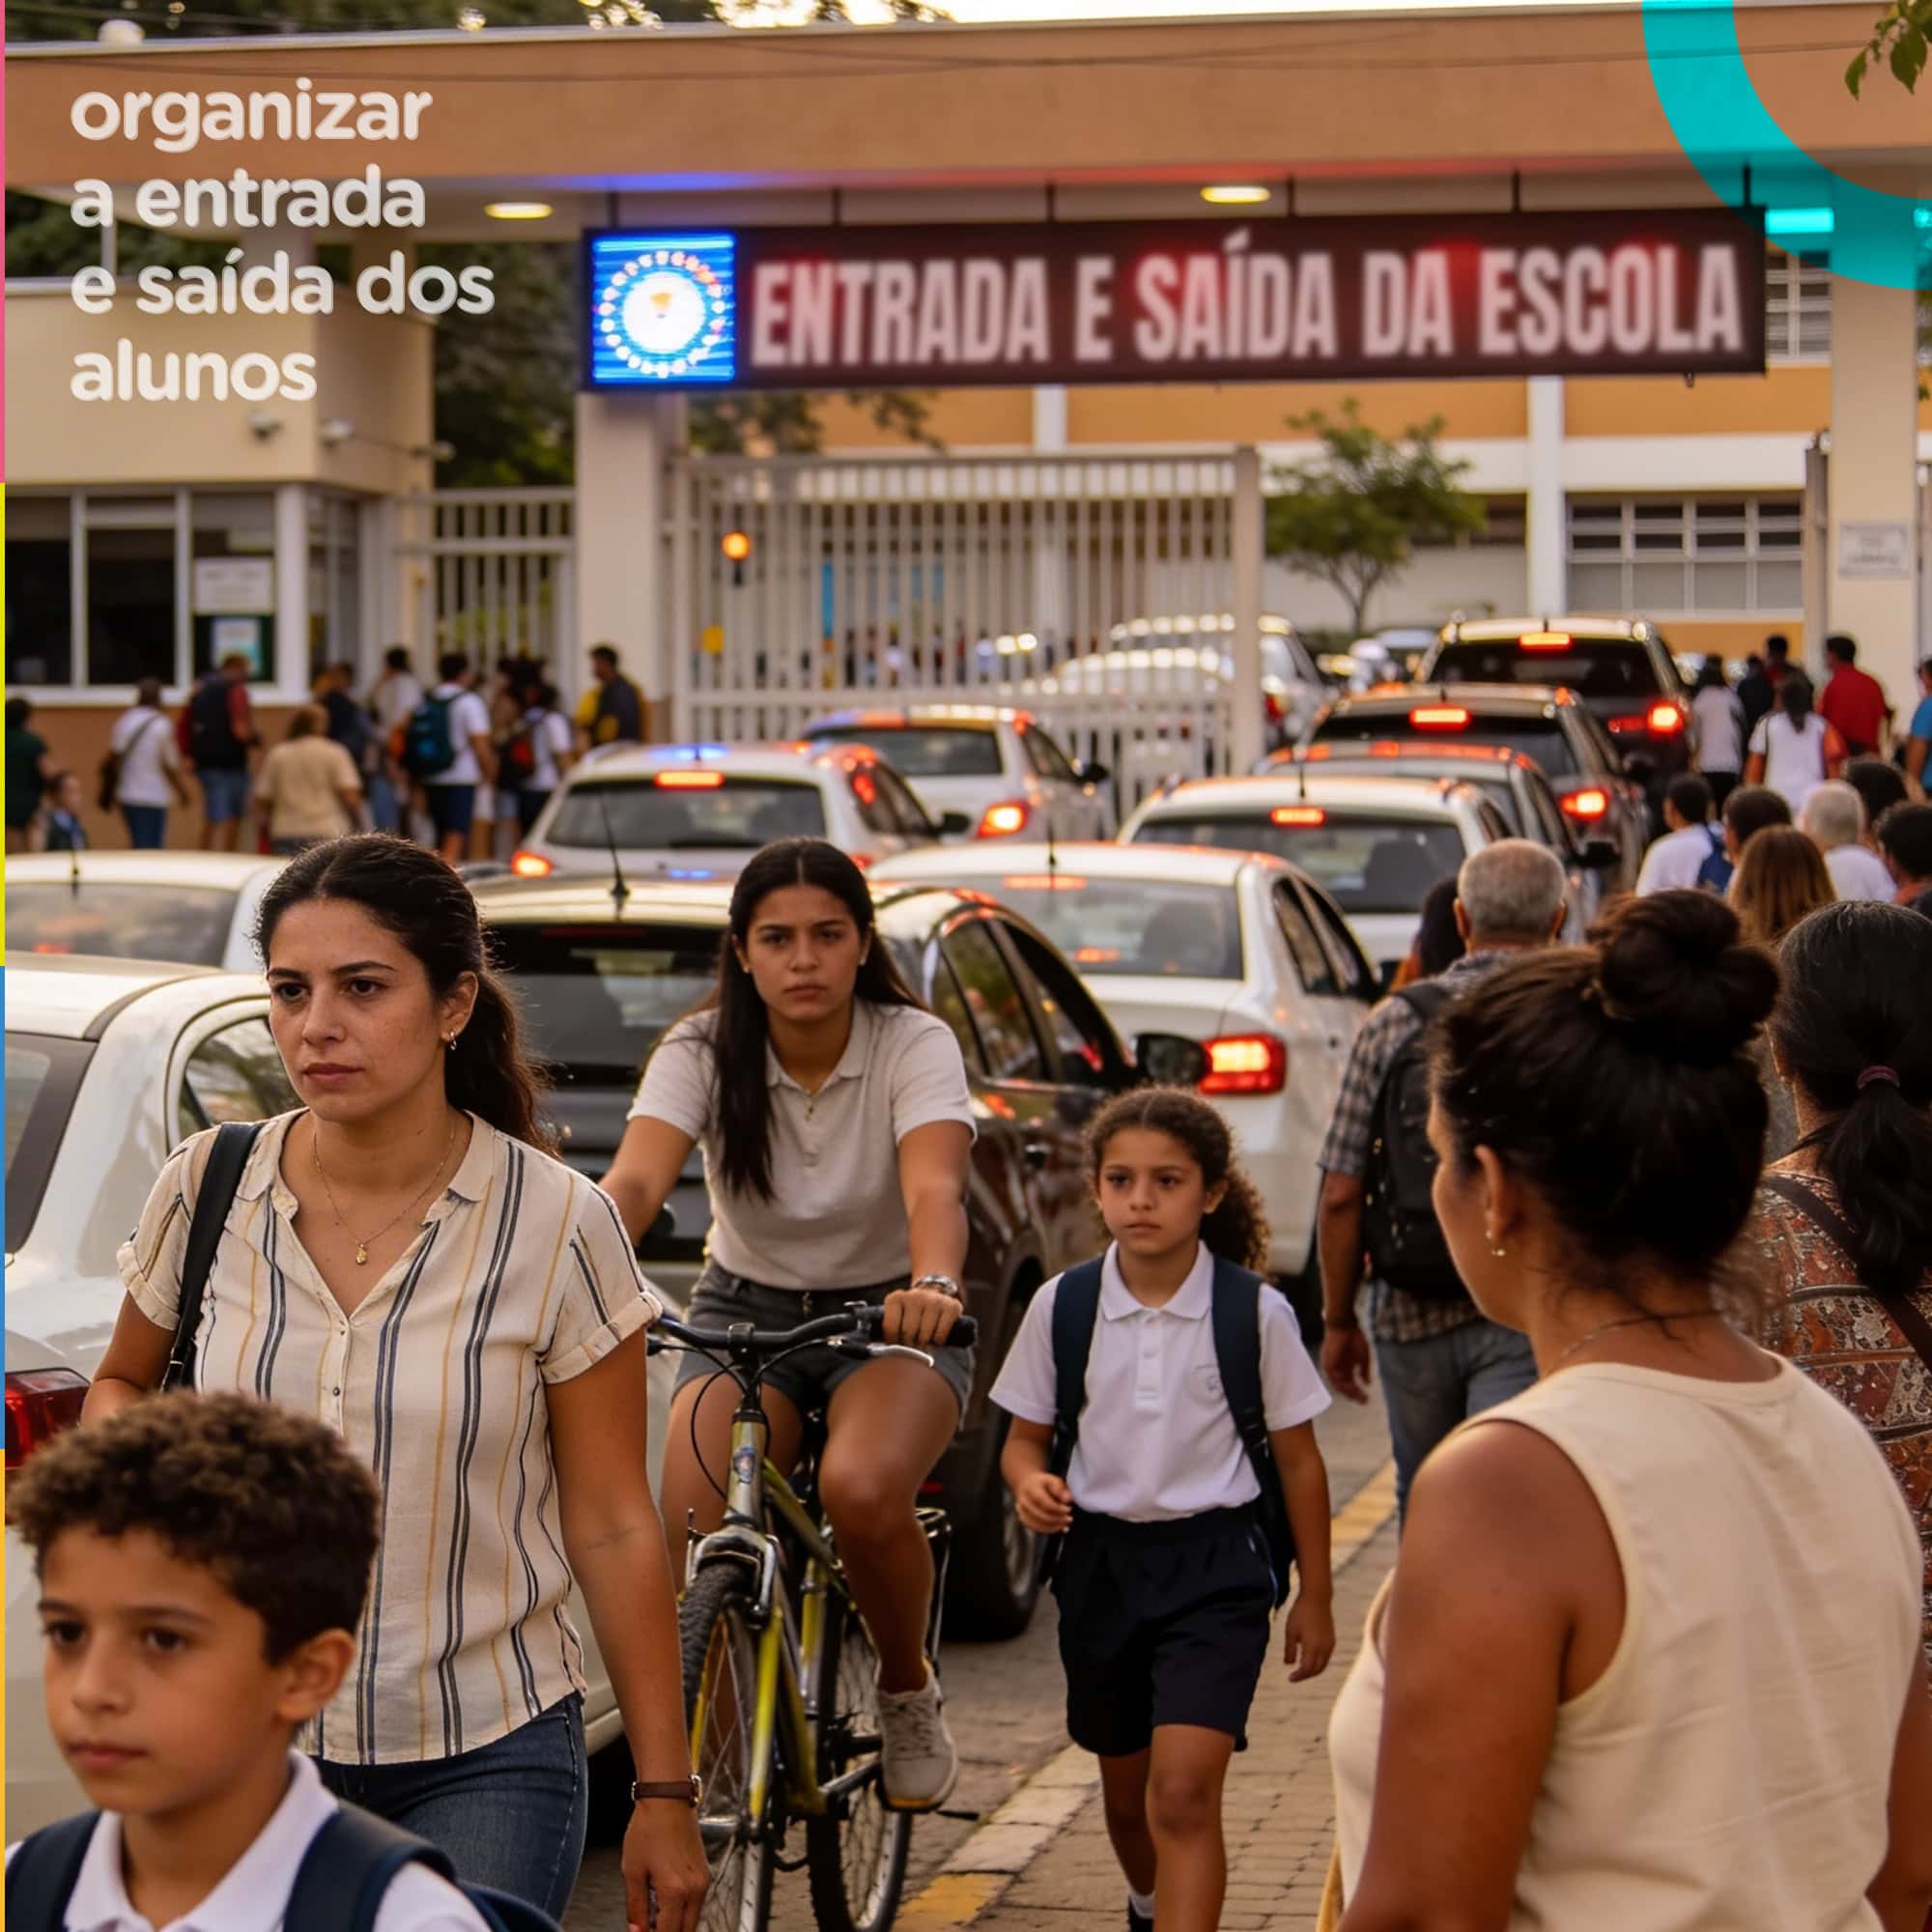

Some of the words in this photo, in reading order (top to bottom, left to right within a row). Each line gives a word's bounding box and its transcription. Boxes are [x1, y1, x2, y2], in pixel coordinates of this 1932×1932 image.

[751, 255, 1049, 366] ENTRADA
[1074, 256, 1114, 361] E
[1134, 229, 1338, 359] SAÍDA
[1362, 250, 1454, 357] DA
[1478, 243, 1744, 355] ESCOLA
